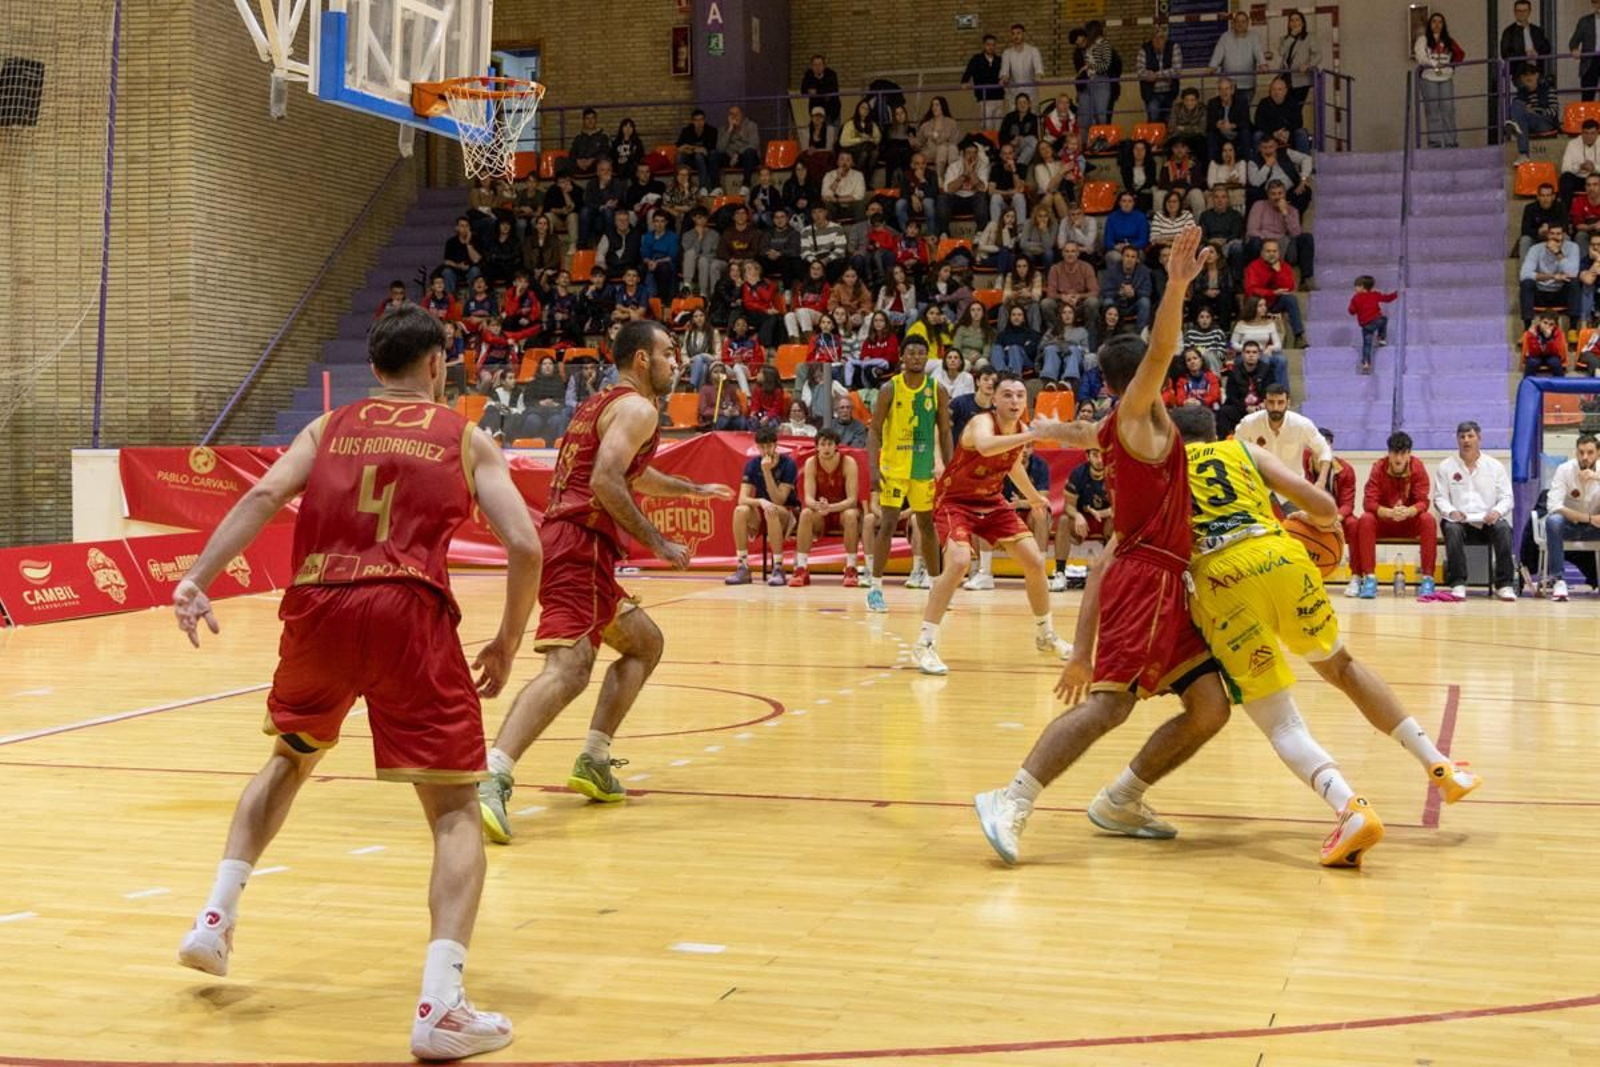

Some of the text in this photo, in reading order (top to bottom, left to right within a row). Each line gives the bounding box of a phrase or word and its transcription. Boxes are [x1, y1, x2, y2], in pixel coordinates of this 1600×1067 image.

[707, 2, 724, 25] A
[329, 436, 446, 462] LUIS RODRIGUEZ
[157, 470, 189, 485] PABLO
[191, 476, 238, 492] CARVAJAL
[357, 464, 397, 543] 4
[22, 586, 80, 606] CAMBIL
